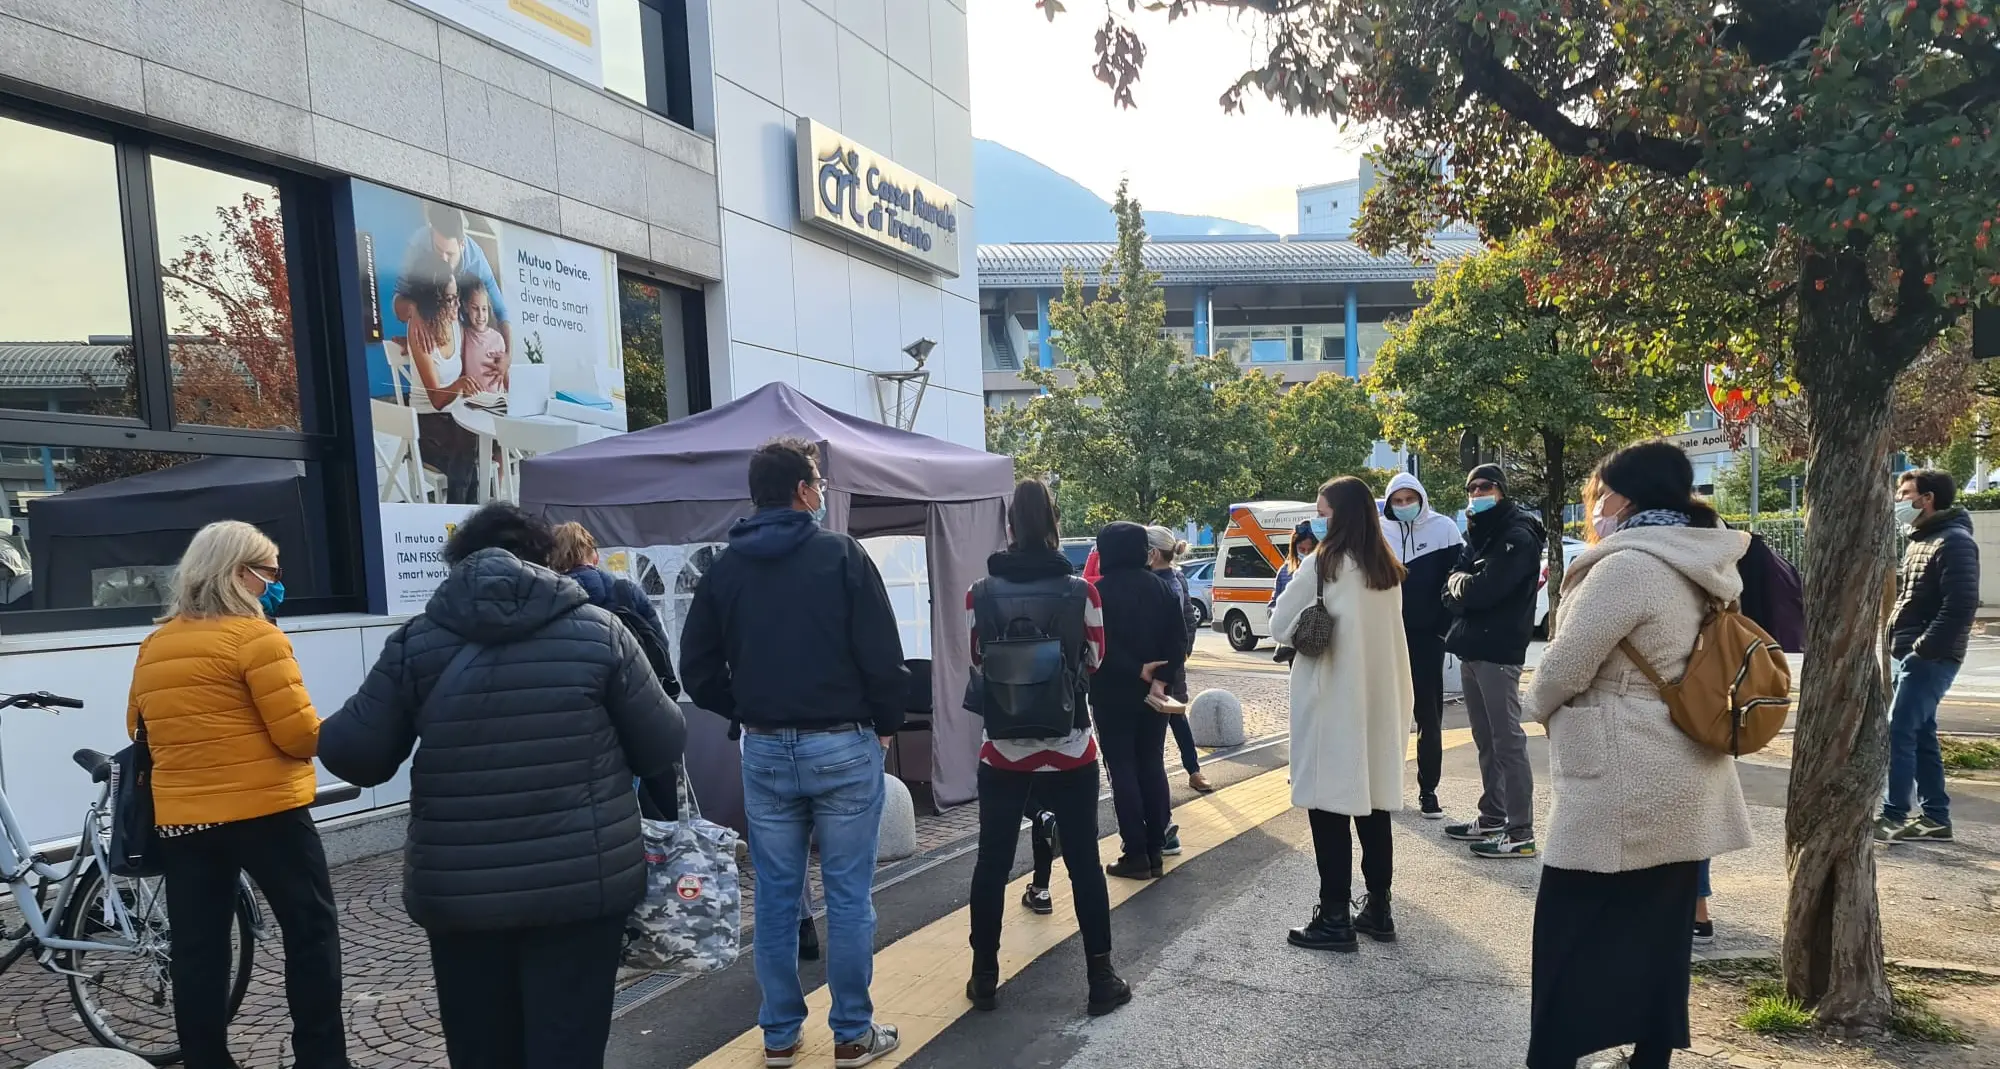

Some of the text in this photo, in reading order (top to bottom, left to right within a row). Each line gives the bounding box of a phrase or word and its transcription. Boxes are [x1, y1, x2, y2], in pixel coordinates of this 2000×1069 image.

[866, 167, 956, 233] Cassa Rurale
[867, 202, 932, 252] di Trento
[517, 249, 591, 281] Mutuo Device.
[519, 268, 561, 292] E la vita
[520, 286, 589, 316] diventa smart
[521, 309, 587, 333] per davvero.
[395, 532, 402, 543] Il
[405, 534, 435, 543] mutuo
[398, 567, 449, 580] smart work
